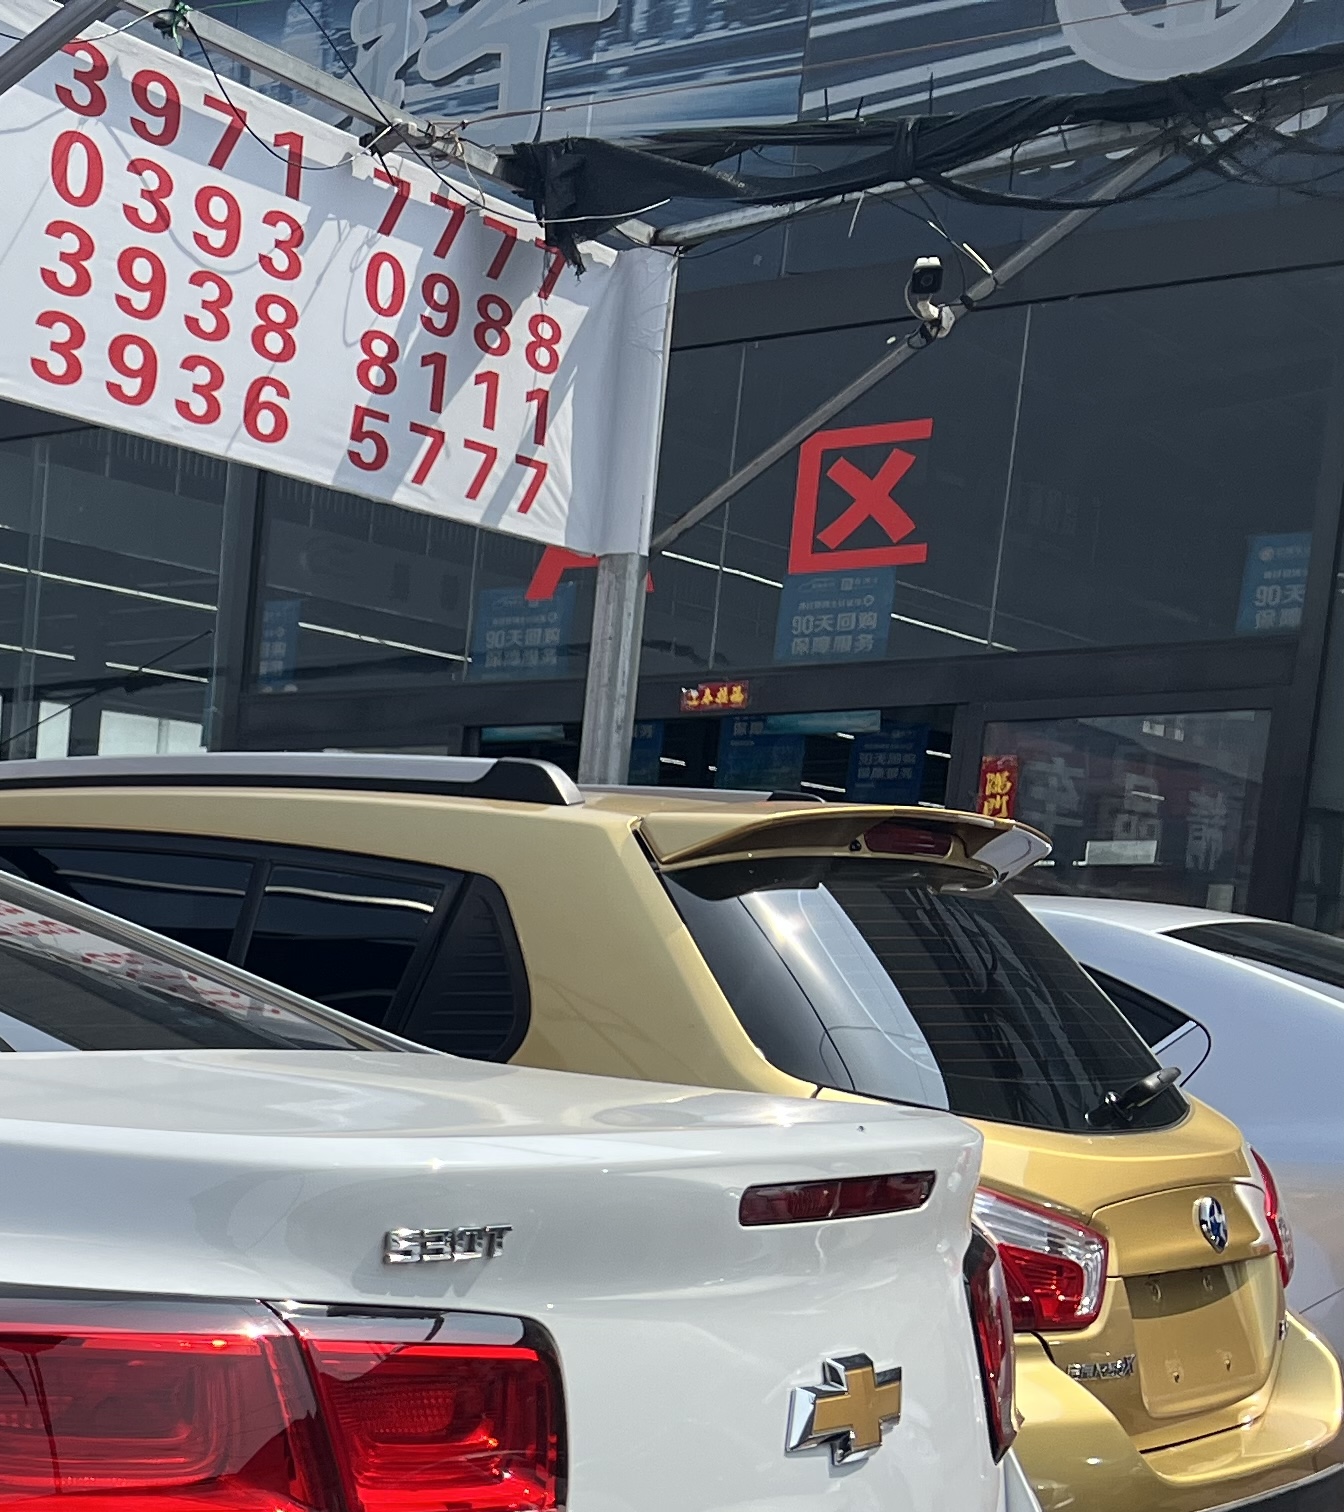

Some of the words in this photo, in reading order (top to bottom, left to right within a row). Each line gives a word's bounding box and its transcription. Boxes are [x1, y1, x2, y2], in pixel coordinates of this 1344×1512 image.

[51, 130, 304, 281] 0393
[365, 251, 562, 375] 0988
[53, 39, 304, 201] 3971
[374, 168, 566, 301] 7777
[30, 310, 290, 444] 3936
[349, 405, 548, 514] 5777
[40, 219, 300, 363] 3938
[356, 329, 549, 444] 8111
